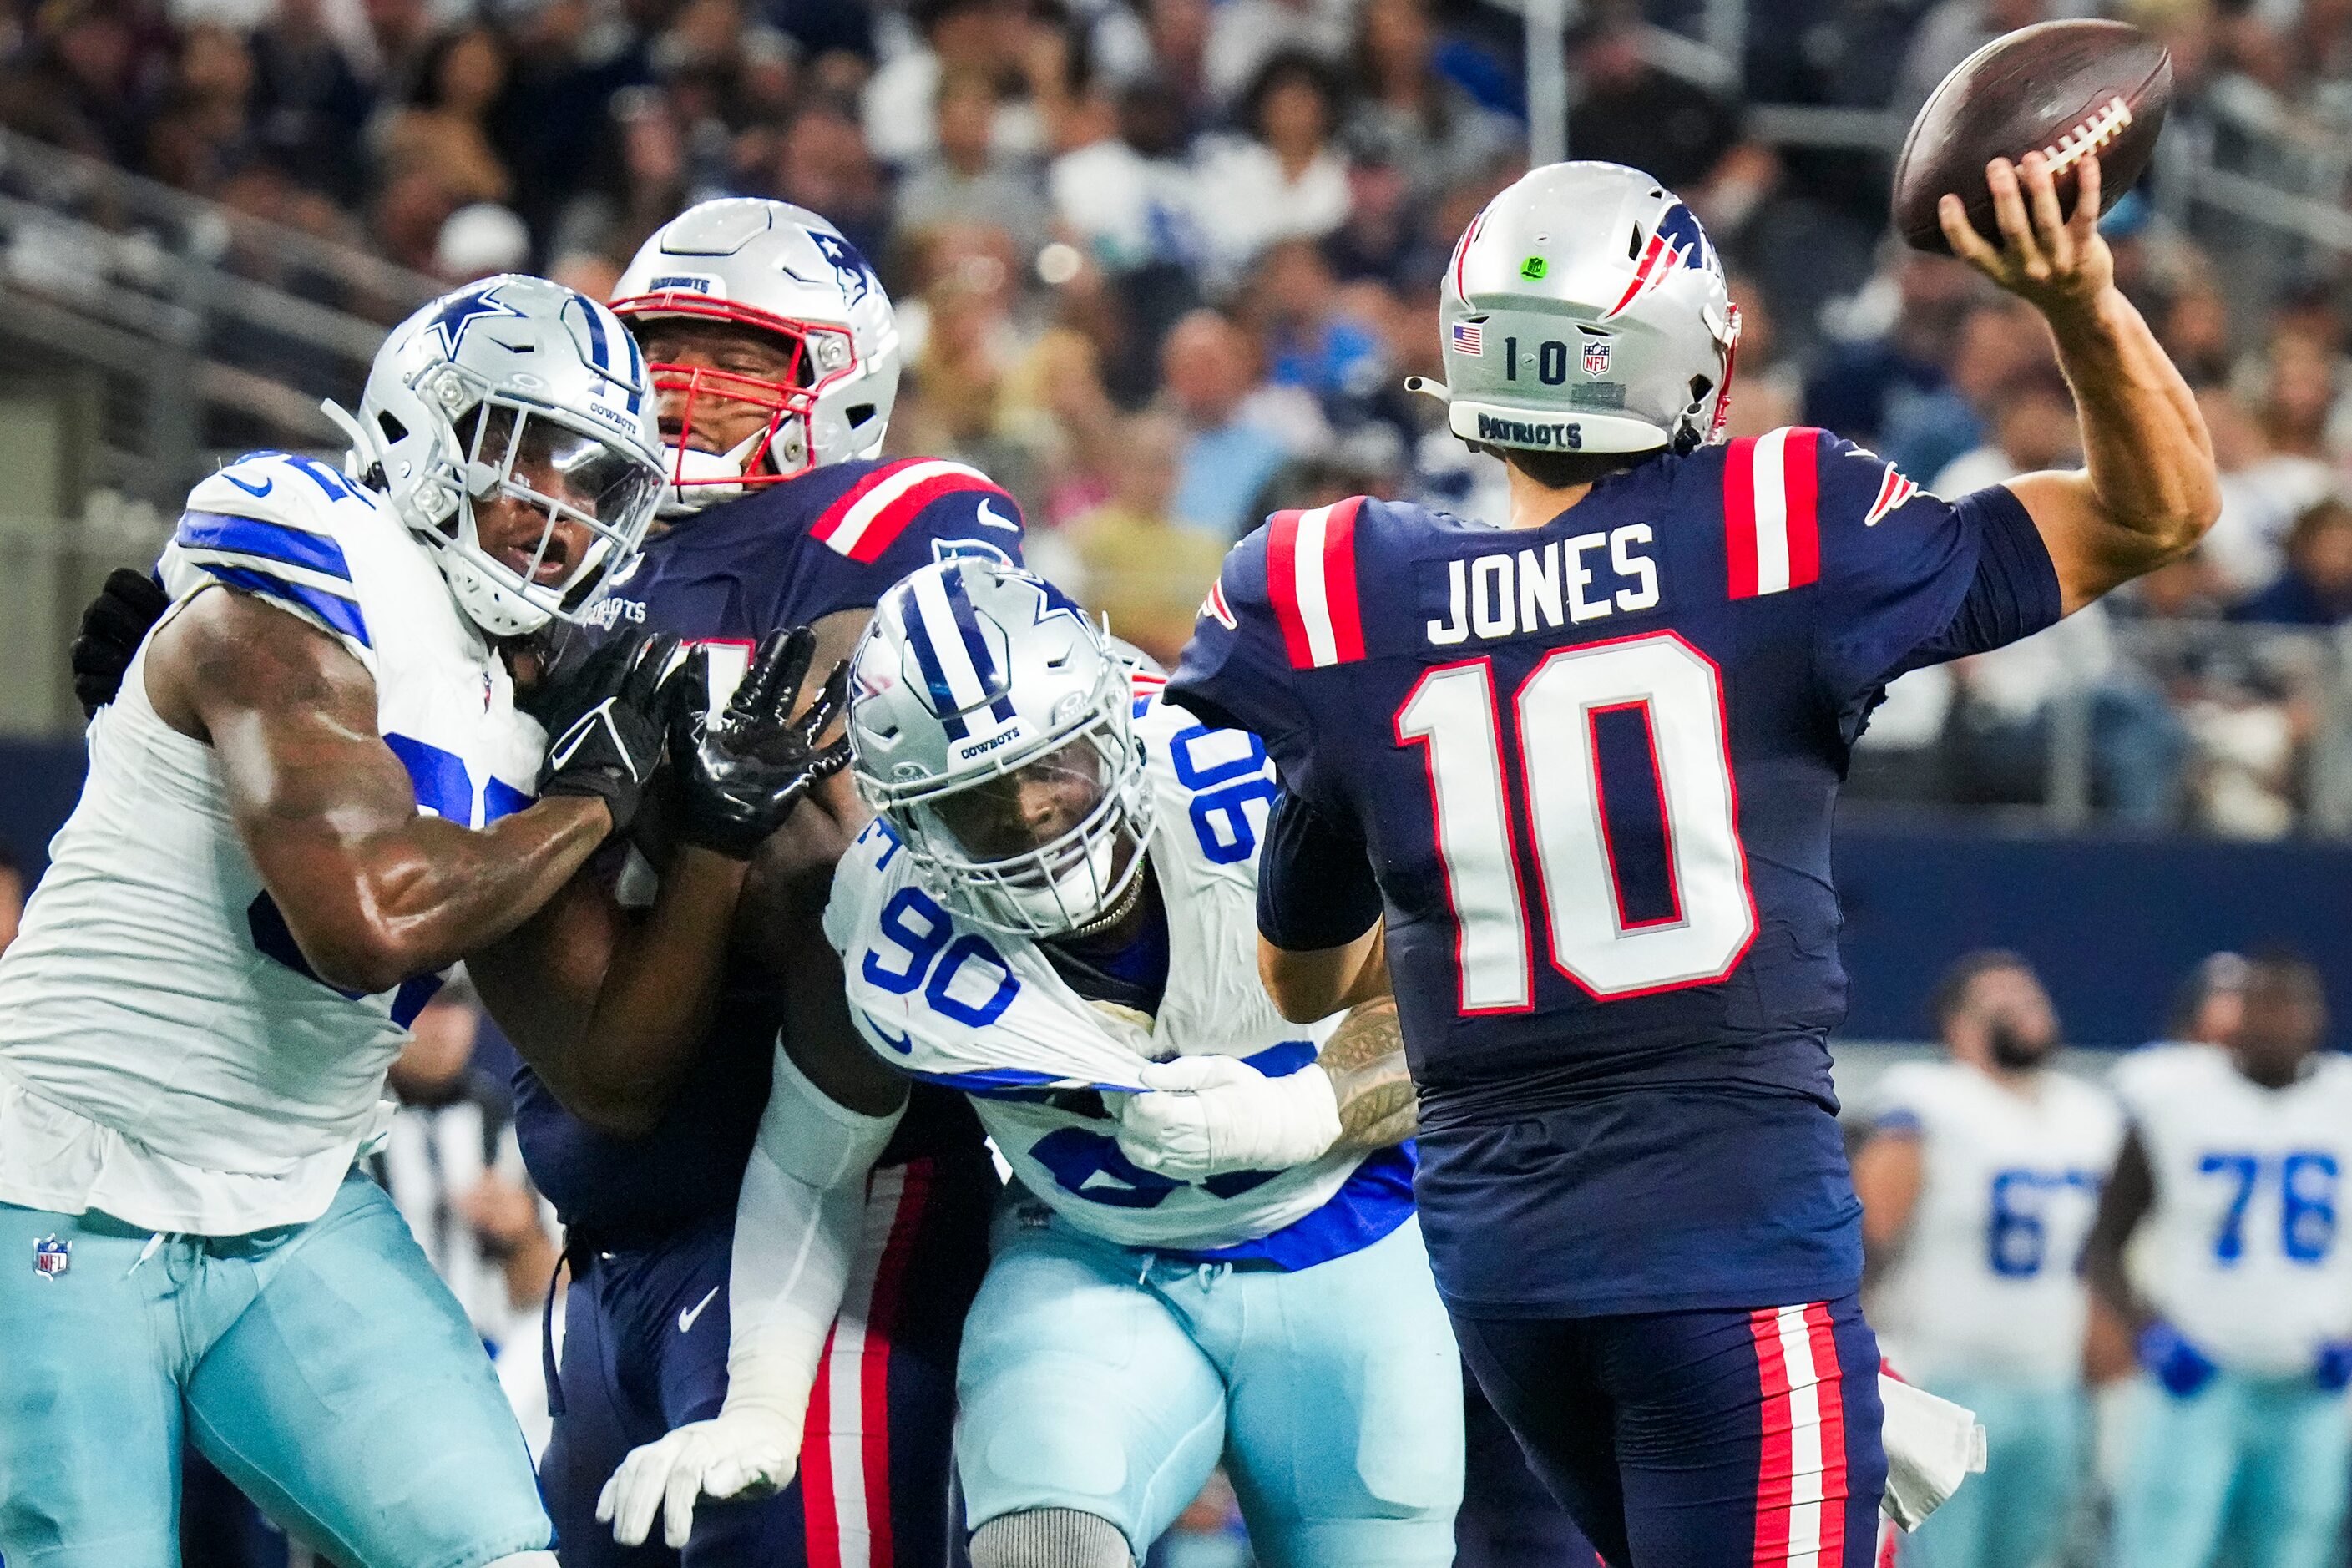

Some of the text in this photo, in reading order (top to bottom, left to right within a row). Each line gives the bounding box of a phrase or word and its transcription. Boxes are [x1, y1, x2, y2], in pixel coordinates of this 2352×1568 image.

[1586, 356, 1606, 372] NFL
[1478, 412, 1582, 448] PATRIOTS
[1426, 523, 1660, 645] JONES
[961, 726, 1020, 759] COWBOYS
[1393, 628, 1760, 1017] 10
[862, 886, 1022, 1029] 90
[2199, 1152, 2340, 1267] 76
[40, 1254, 65, 1272] NFL
